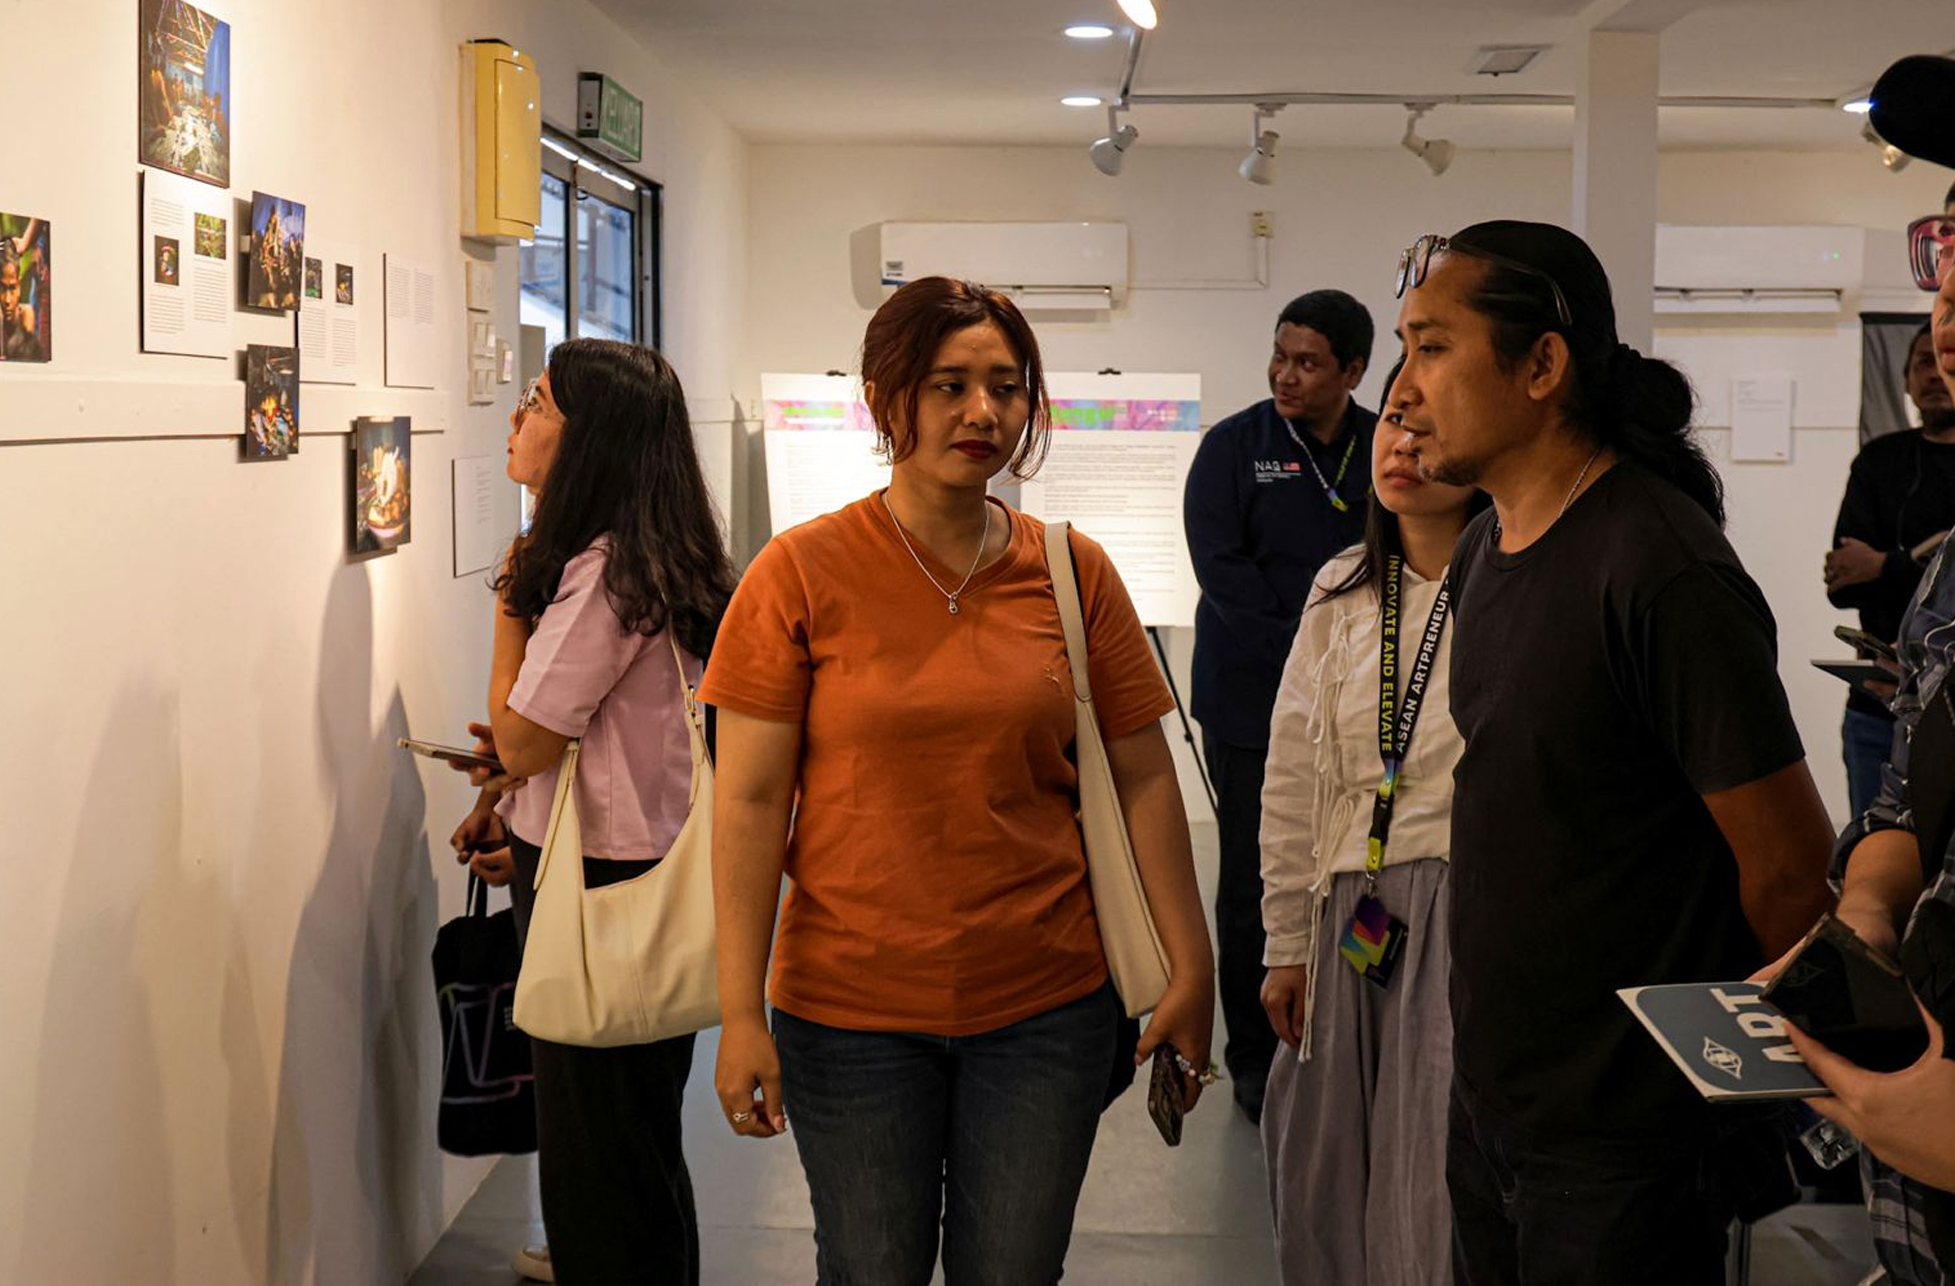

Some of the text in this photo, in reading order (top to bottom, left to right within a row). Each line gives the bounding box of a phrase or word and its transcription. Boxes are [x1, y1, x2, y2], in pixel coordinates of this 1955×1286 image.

[1381, 554, 1400, 751] INNOVATE AND ELEVATE
[1395, 591, 1450, 754] ASEAN ARTPRENEUR
